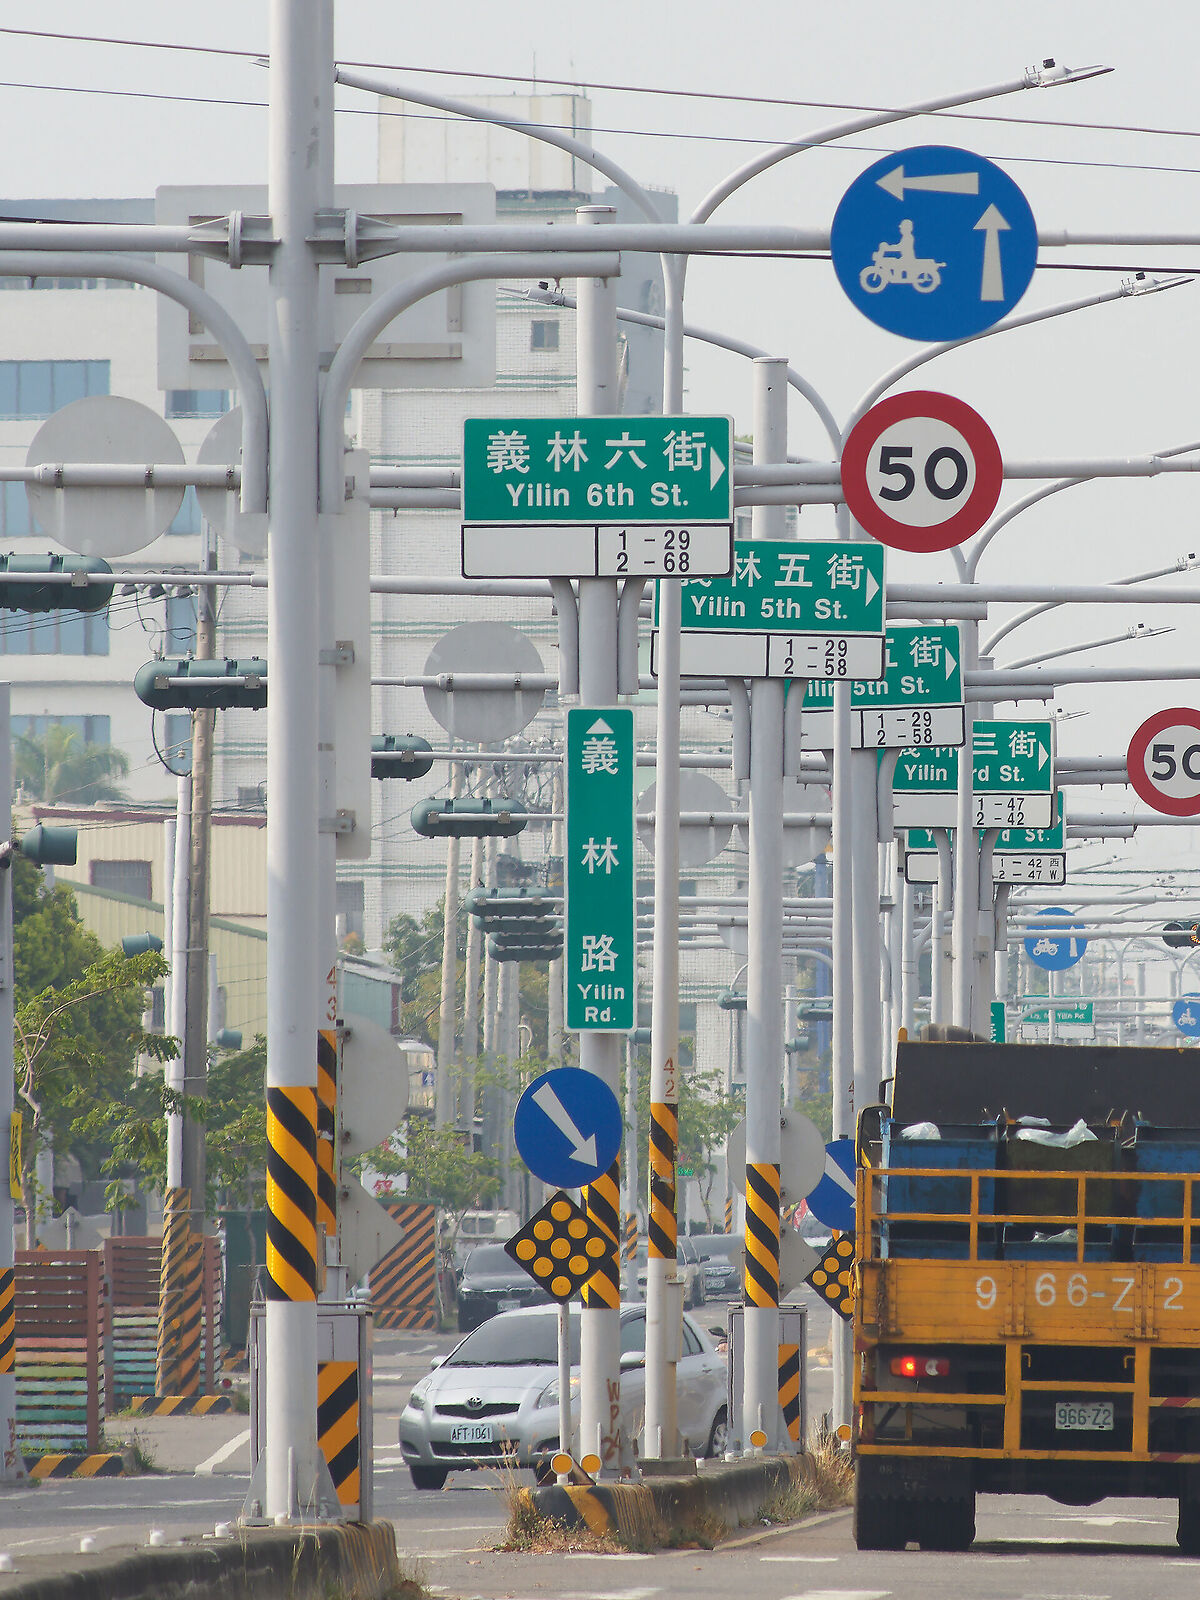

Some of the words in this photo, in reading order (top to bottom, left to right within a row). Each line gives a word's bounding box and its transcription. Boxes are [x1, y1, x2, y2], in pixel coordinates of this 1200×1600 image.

[486, 430, 706, 474] 義林六街
[878, 445, 968, 502] 50
[505, 482, 570, 507] Yilin
[586, 482, 634, 507] 6th
[650, 481, 689, 507] St.
[681, 551, 865, 590] 林五街
[690, 595, 746, 617] Yilin
[760, 598, 801, 619] 5th
[814, 598, 848, 620] St.
[900, 675, 930, 695] St.
[904, 764, 948, 781] Yilin
[999, 764, 1025, 782] St.
[581, 736, 620, 973] 義林路
[577, 984, 625, 1000] Yilin
[585, 1006, 617, 1023] Rd.
[1058, 1408, 1112, 1426] 966-Z2
